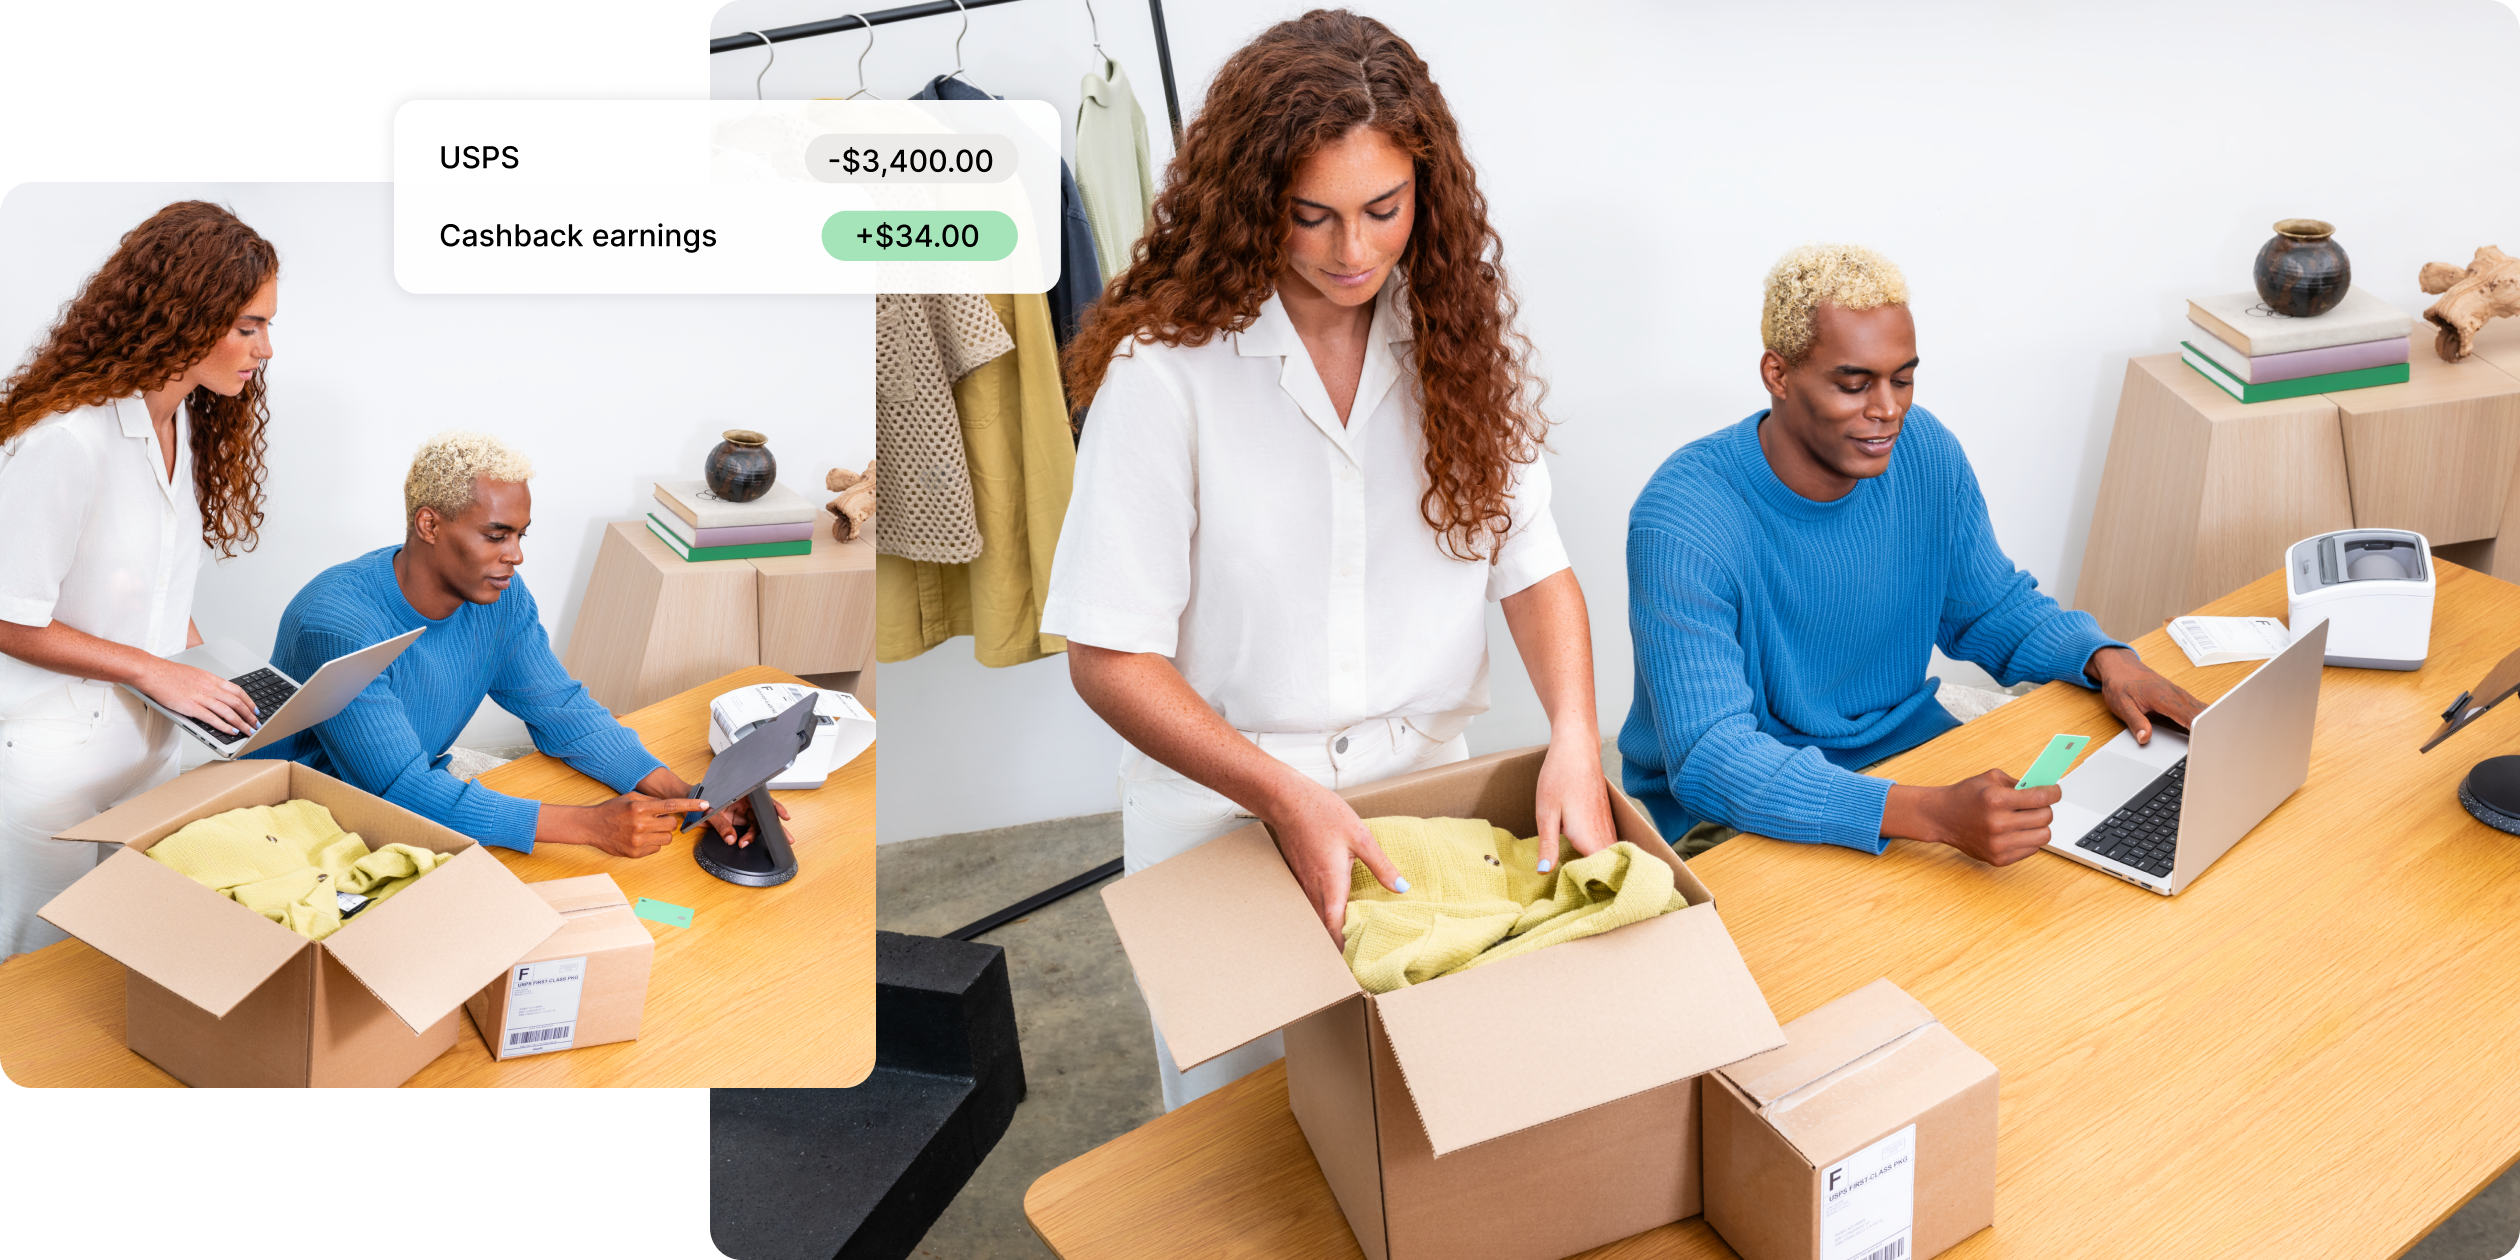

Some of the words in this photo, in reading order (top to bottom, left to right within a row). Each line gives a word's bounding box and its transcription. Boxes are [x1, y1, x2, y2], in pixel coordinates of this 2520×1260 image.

[519, 967, 530, 981] F
[1828, 1187, 1848, 1202] USPS
[1849, 1164, 1893, 1191] FIRST-CLASS
[1893, 1155, 1908, 1168] PKG
[1829, 1167, 1842, 1191] F
